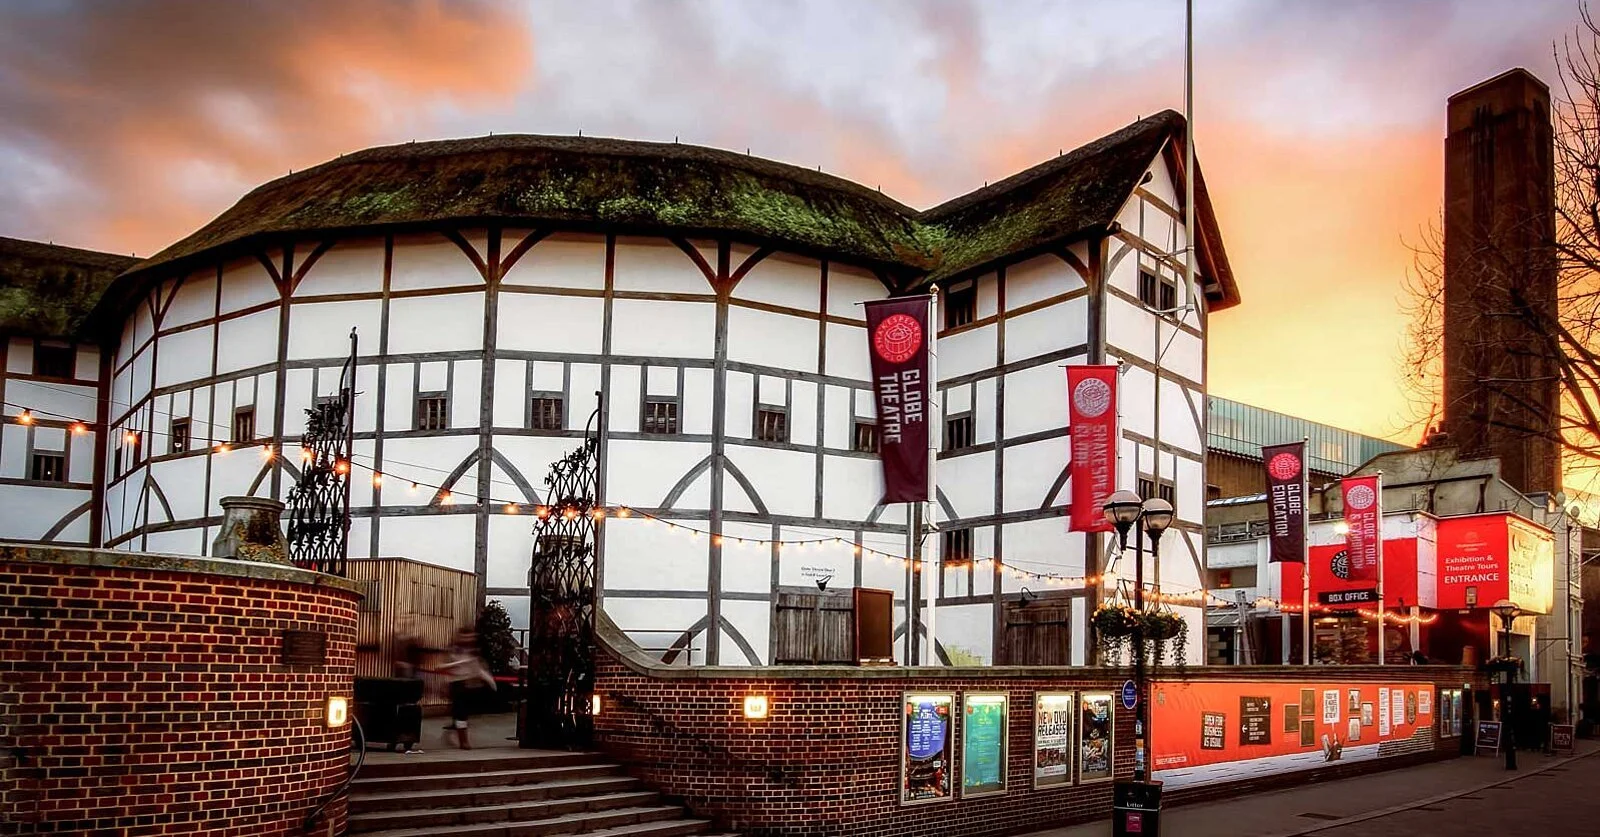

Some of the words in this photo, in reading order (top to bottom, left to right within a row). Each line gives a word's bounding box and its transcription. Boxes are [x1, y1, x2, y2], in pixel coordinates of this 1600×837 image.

[902, 369, 922, 425] GLOBE
[879, 372, 901, 444] THEATRE
[1091, 424, 1109, 527] SHAKESPEARES
[1287, 483, 1300, 515] GLOBE
[1272, 485, 1289, 537] EDUCATION
[1363, 512, 1374, 540] GLOBE
[1365, 543, 1377, 566] TOUR
[1445, 555, 1485, 564] Exhibition
[1446, 564, 1475, 572] Theatre
[1477, 563, 1499, 571] Tours
[1444, 573, 1499, 584] ENTRANCE
[1328, 593, 1342, 602] BOX
[1344, 591, 1369, 601] OFFICE
[1038, 711, 1053, 725] NEW
[1054, 710, 1067, 724] DVD
[1204, 714, 1215, 725] OPEN
[1215, 715, 1223, 726] FOR
[1037, 723, 1067, 737] RELEASES
[1204, 726, 1223, 737] BUSINESS
